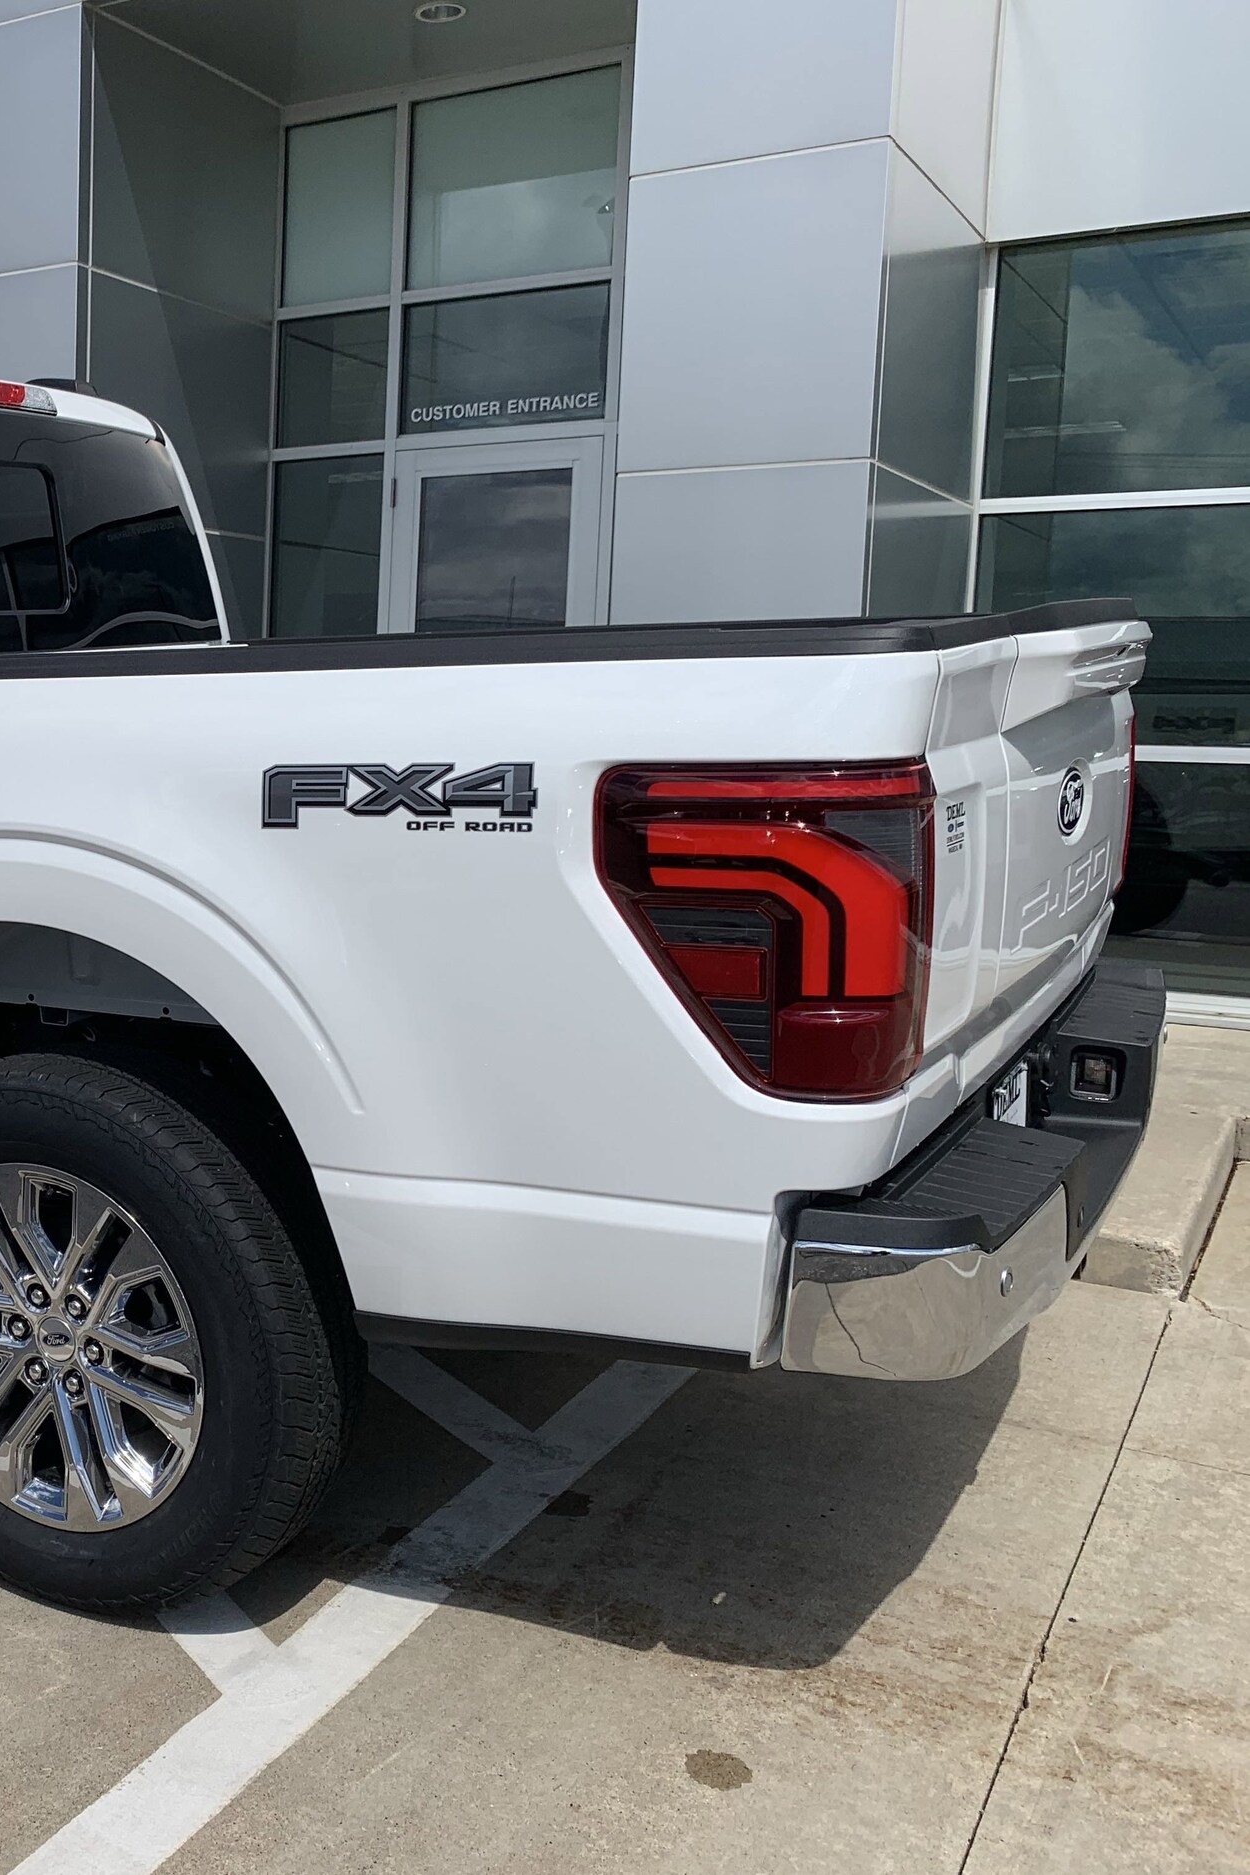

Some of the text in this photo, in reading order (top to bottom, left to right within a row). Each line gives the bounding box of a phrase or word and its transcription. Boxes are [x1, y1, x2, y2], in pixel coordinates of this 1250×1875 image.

[410, 392, 600, 423] CUSTOMER ENTRANCE
[261, 762, 538, 829] FX4
[946, 801, 966, 821] DEML
[406, 820, 533, 833] OFF ROAD
[1011, 836, 1111, 955] F-150
[46, 1334, 66, 1346] Ford
